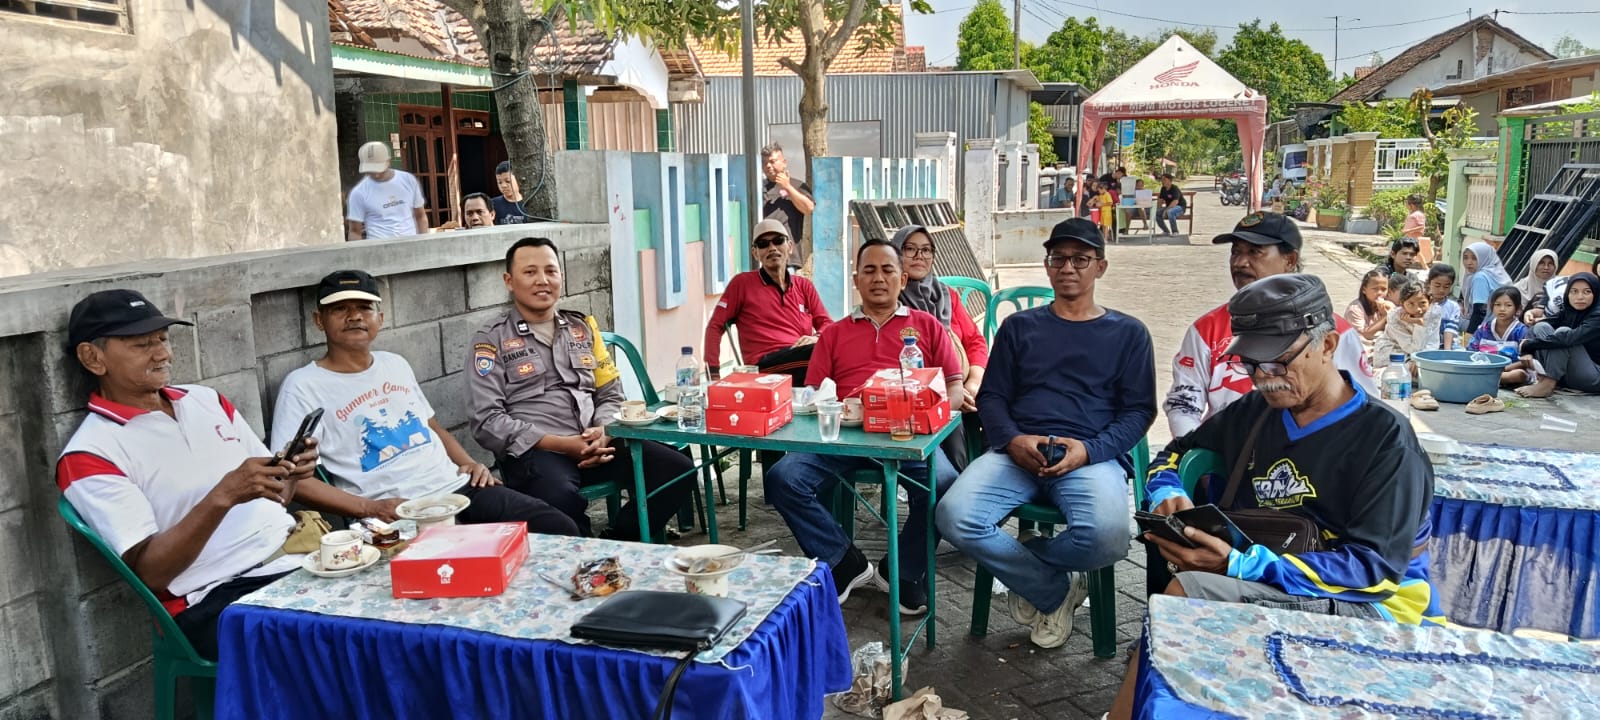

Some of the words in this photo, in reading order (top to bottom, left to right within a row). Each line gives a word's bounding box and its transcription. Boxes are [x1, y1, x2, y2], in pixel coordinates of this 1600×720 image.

[1149, 81, 1200, 90] HONDA
[1157, 99, 1200, 110] MOTOR
[502, 349, 529, 364] DANANG
[335, 388, 379, 422] Summer
